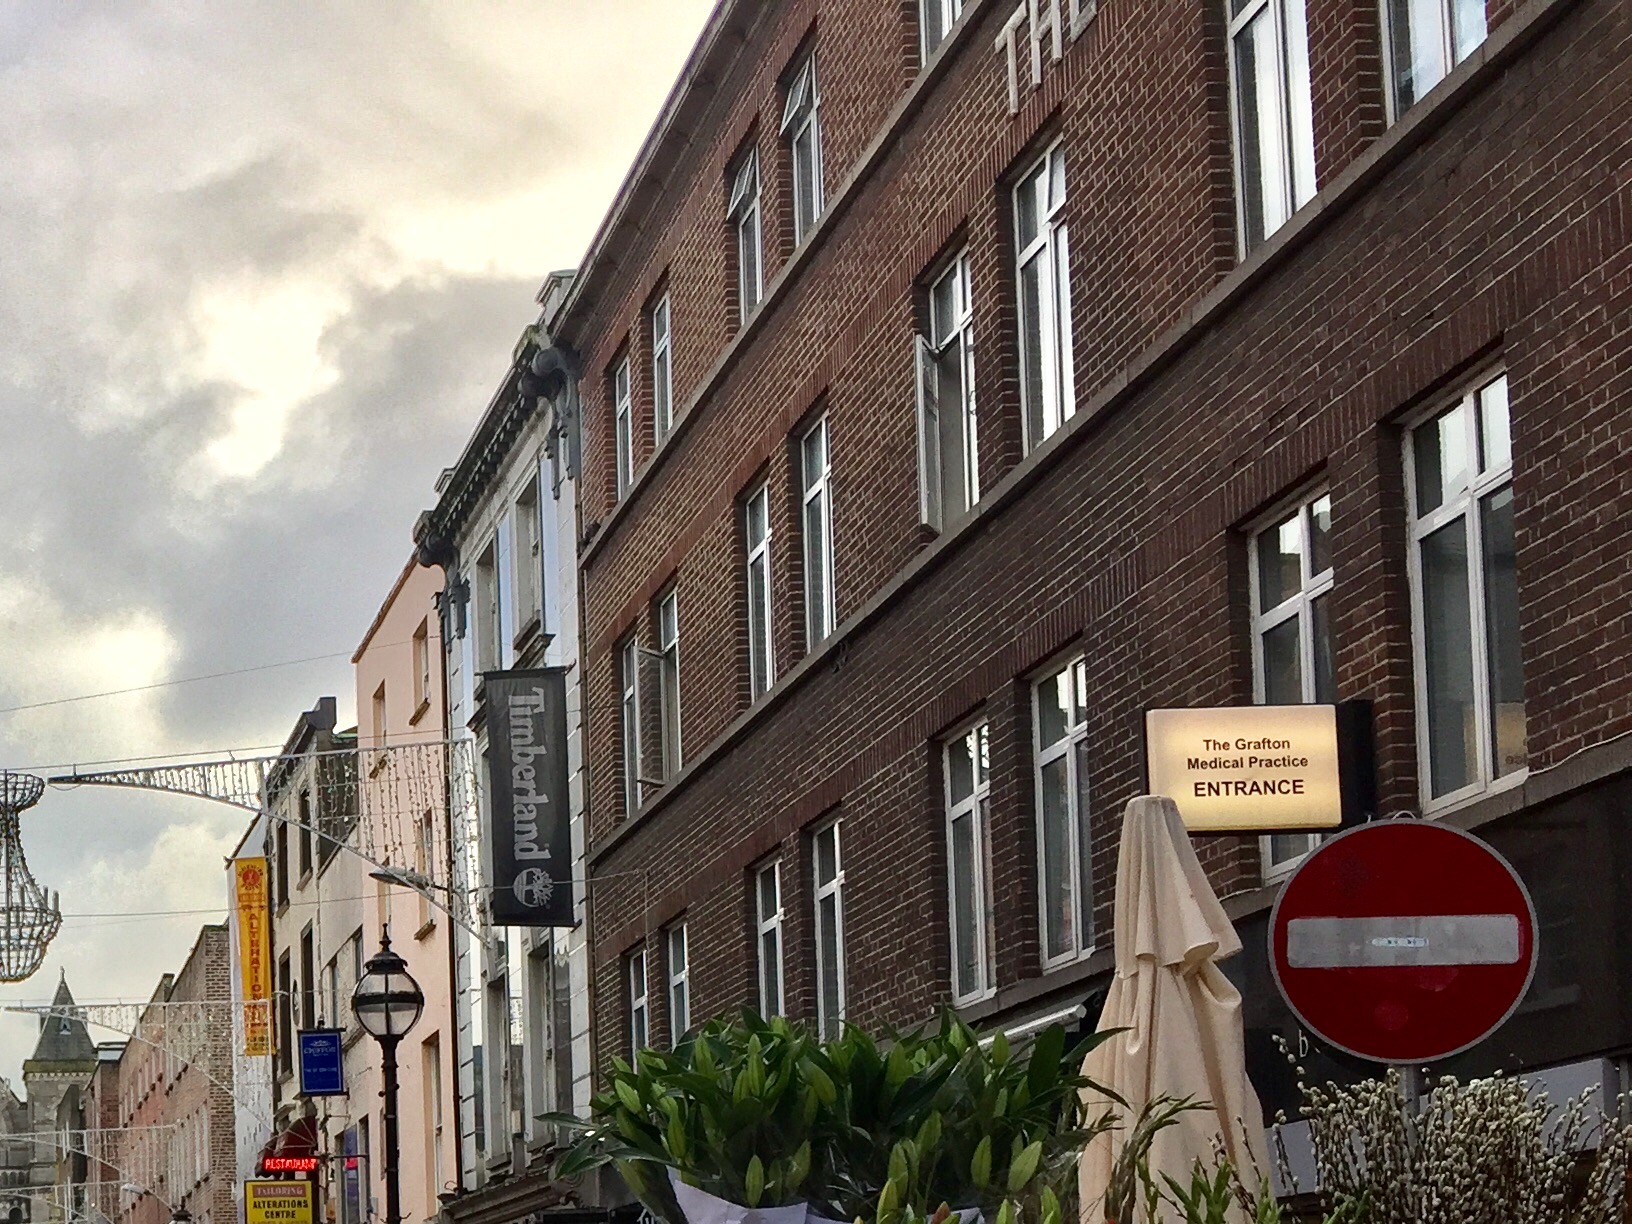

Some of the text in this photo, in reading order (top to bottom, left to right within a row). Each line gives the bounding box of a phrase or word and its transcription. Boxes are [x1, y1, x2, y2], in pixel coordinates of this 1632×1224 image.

[1202, 738, 1291, 751] The Grafton
[1187, 755, 1309, 769] Medical Practice
[508, 687, 552, 861] Timberland
[1193, 779, 1305, 797] ENTRANCE
[257, 1186, 303, 1196] TAILORING
[253, 1199, 309, 1209] ALTERATIONS
[264, 1210, 296, 1219] CENTRE
